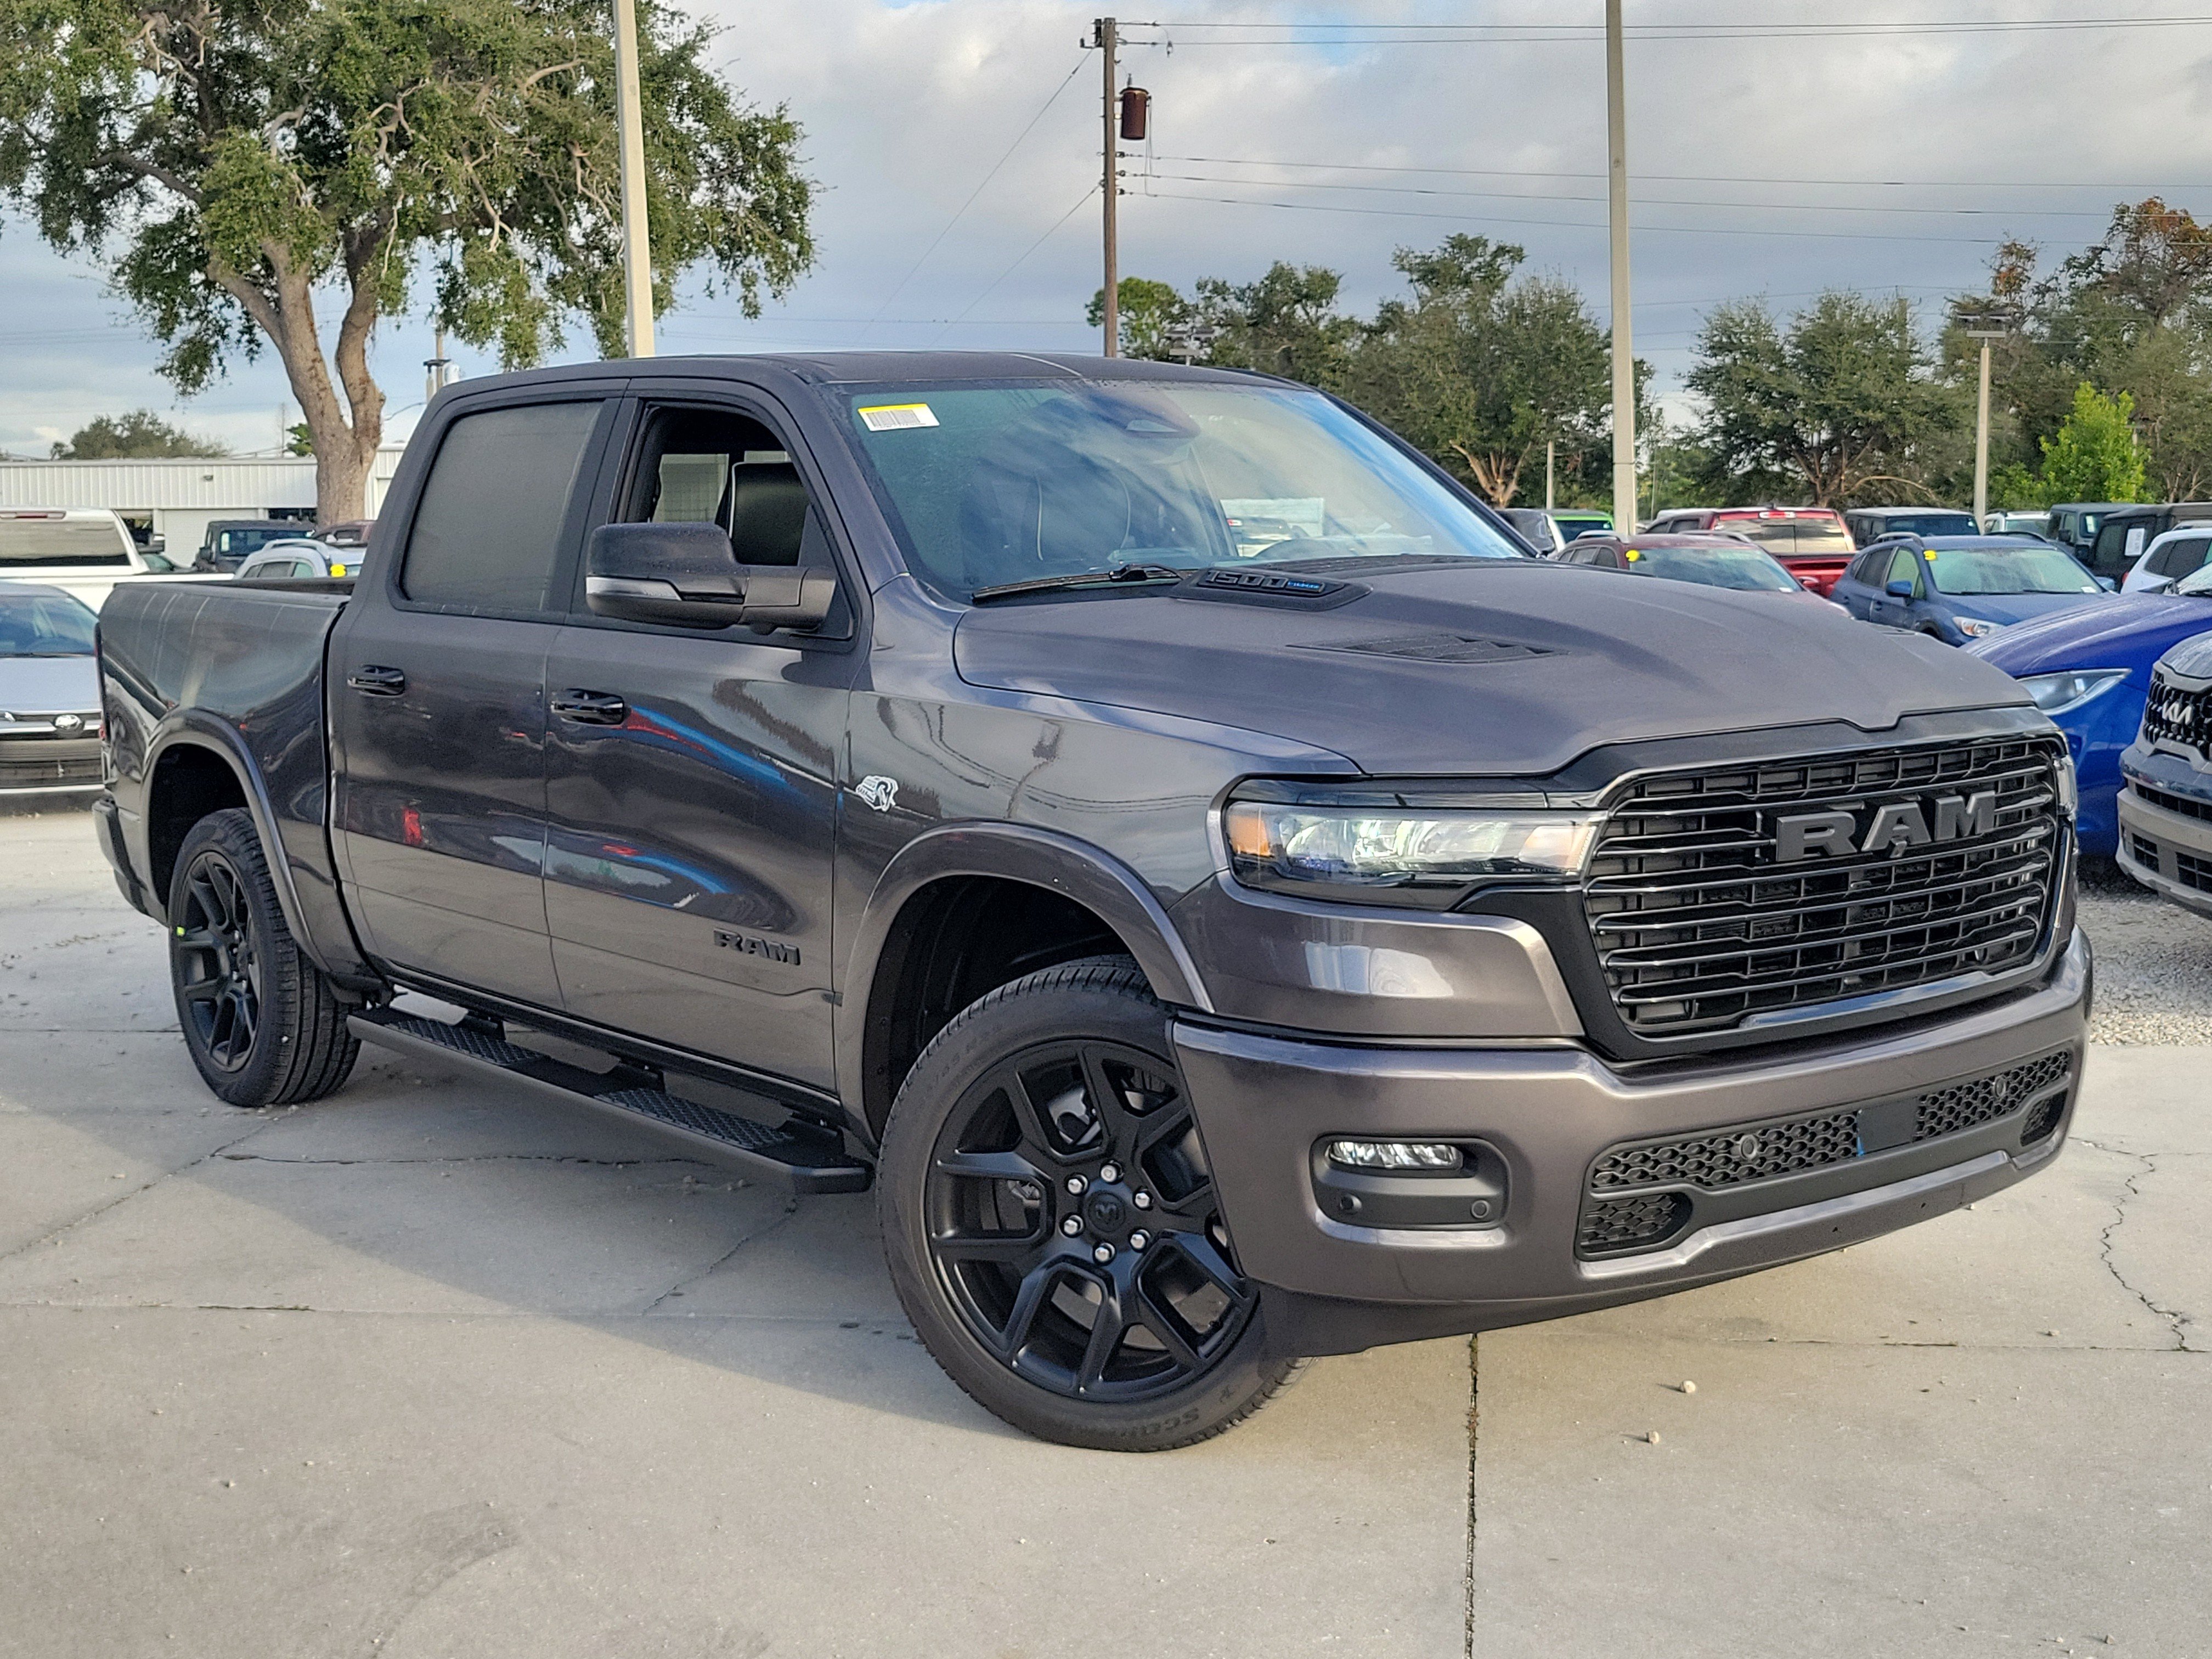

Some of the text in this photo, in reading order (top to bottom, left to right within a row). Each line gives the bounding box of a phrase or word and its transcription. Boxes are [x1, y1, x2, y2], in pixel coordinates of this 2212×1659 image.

[1206, 569, 1289, 589] 1500
[1776, 789, 1996, 862] RAM
[713, 927, 801, 966] RAM
